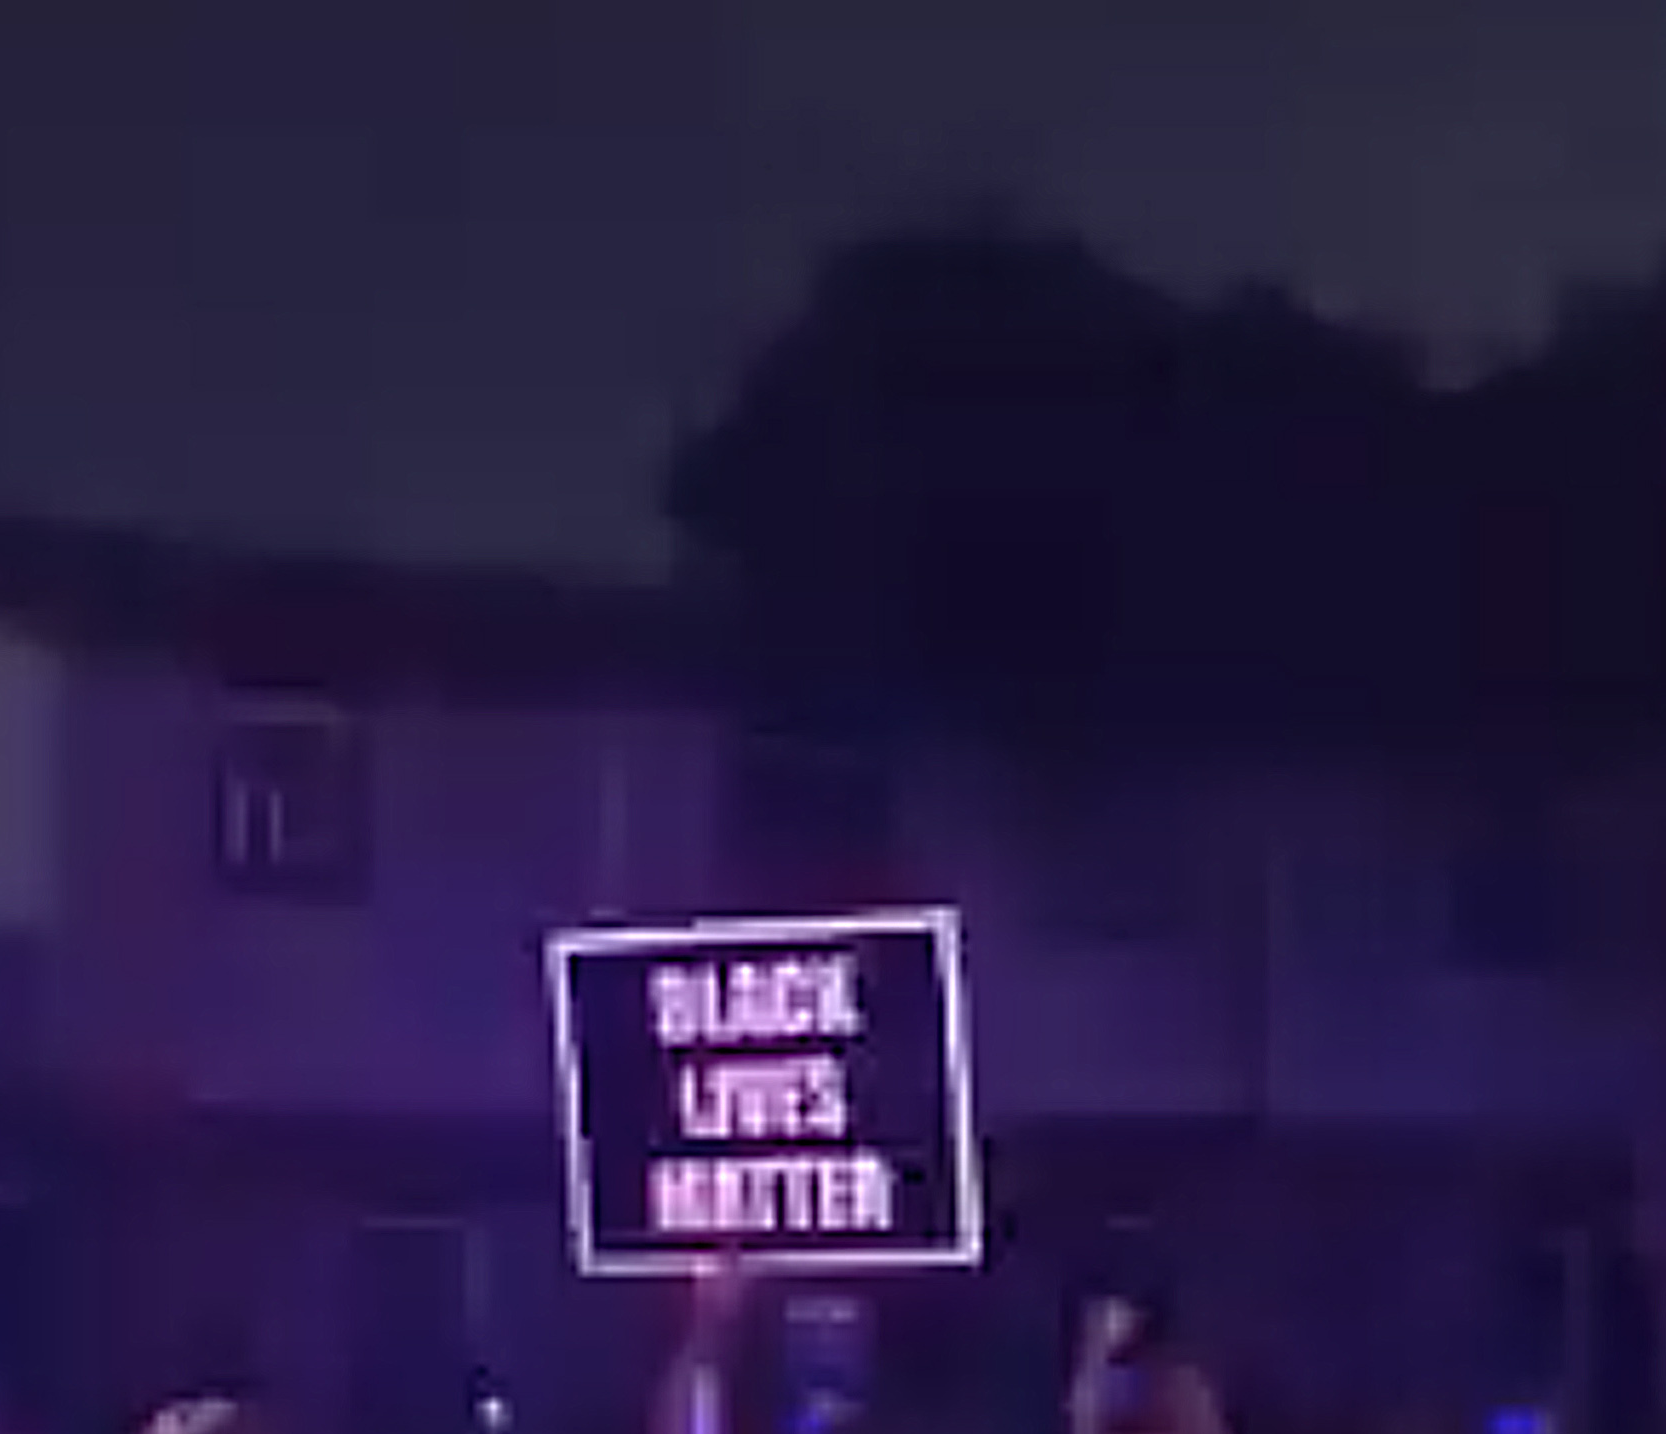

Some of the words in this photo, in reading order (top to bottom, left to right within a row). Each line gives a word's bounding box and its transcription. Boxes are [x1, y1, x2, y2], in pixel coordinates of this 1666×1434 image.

[651, 954, 863, 1047] BLACK
[680, 1056, 848, 1139] LIVES
[648, 1149, 893, 1232] MATTER
